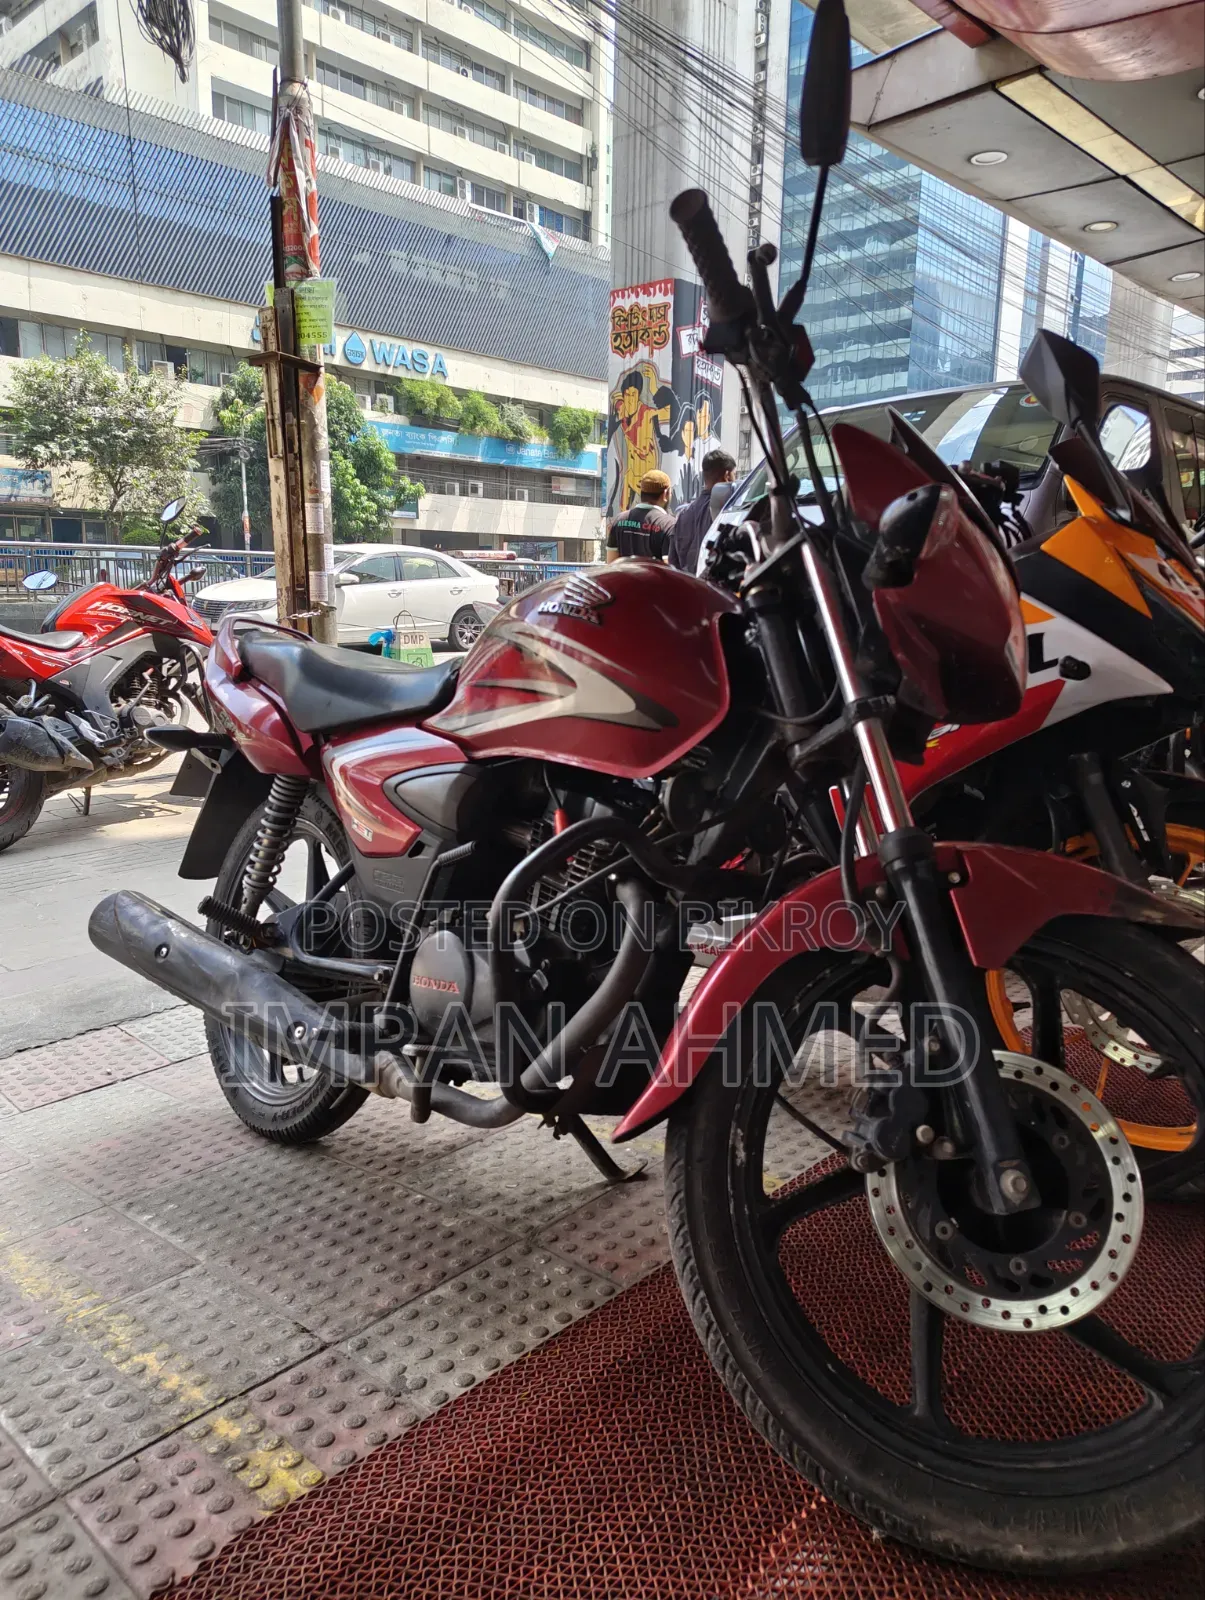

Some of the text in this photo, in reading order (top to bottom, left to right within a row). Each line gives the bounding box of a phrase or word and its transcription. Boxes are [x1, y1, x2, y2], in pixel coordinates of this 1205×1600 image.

[369, 339, 448, 377] WASA
[516, 446, 543, 458] Janata
[86, 601, 171, 625] HORNET
[538, 601, 601, 624] HONDA
[403, 634, 424, 645] DMP
[412, 974, 460, 994] HONDA
